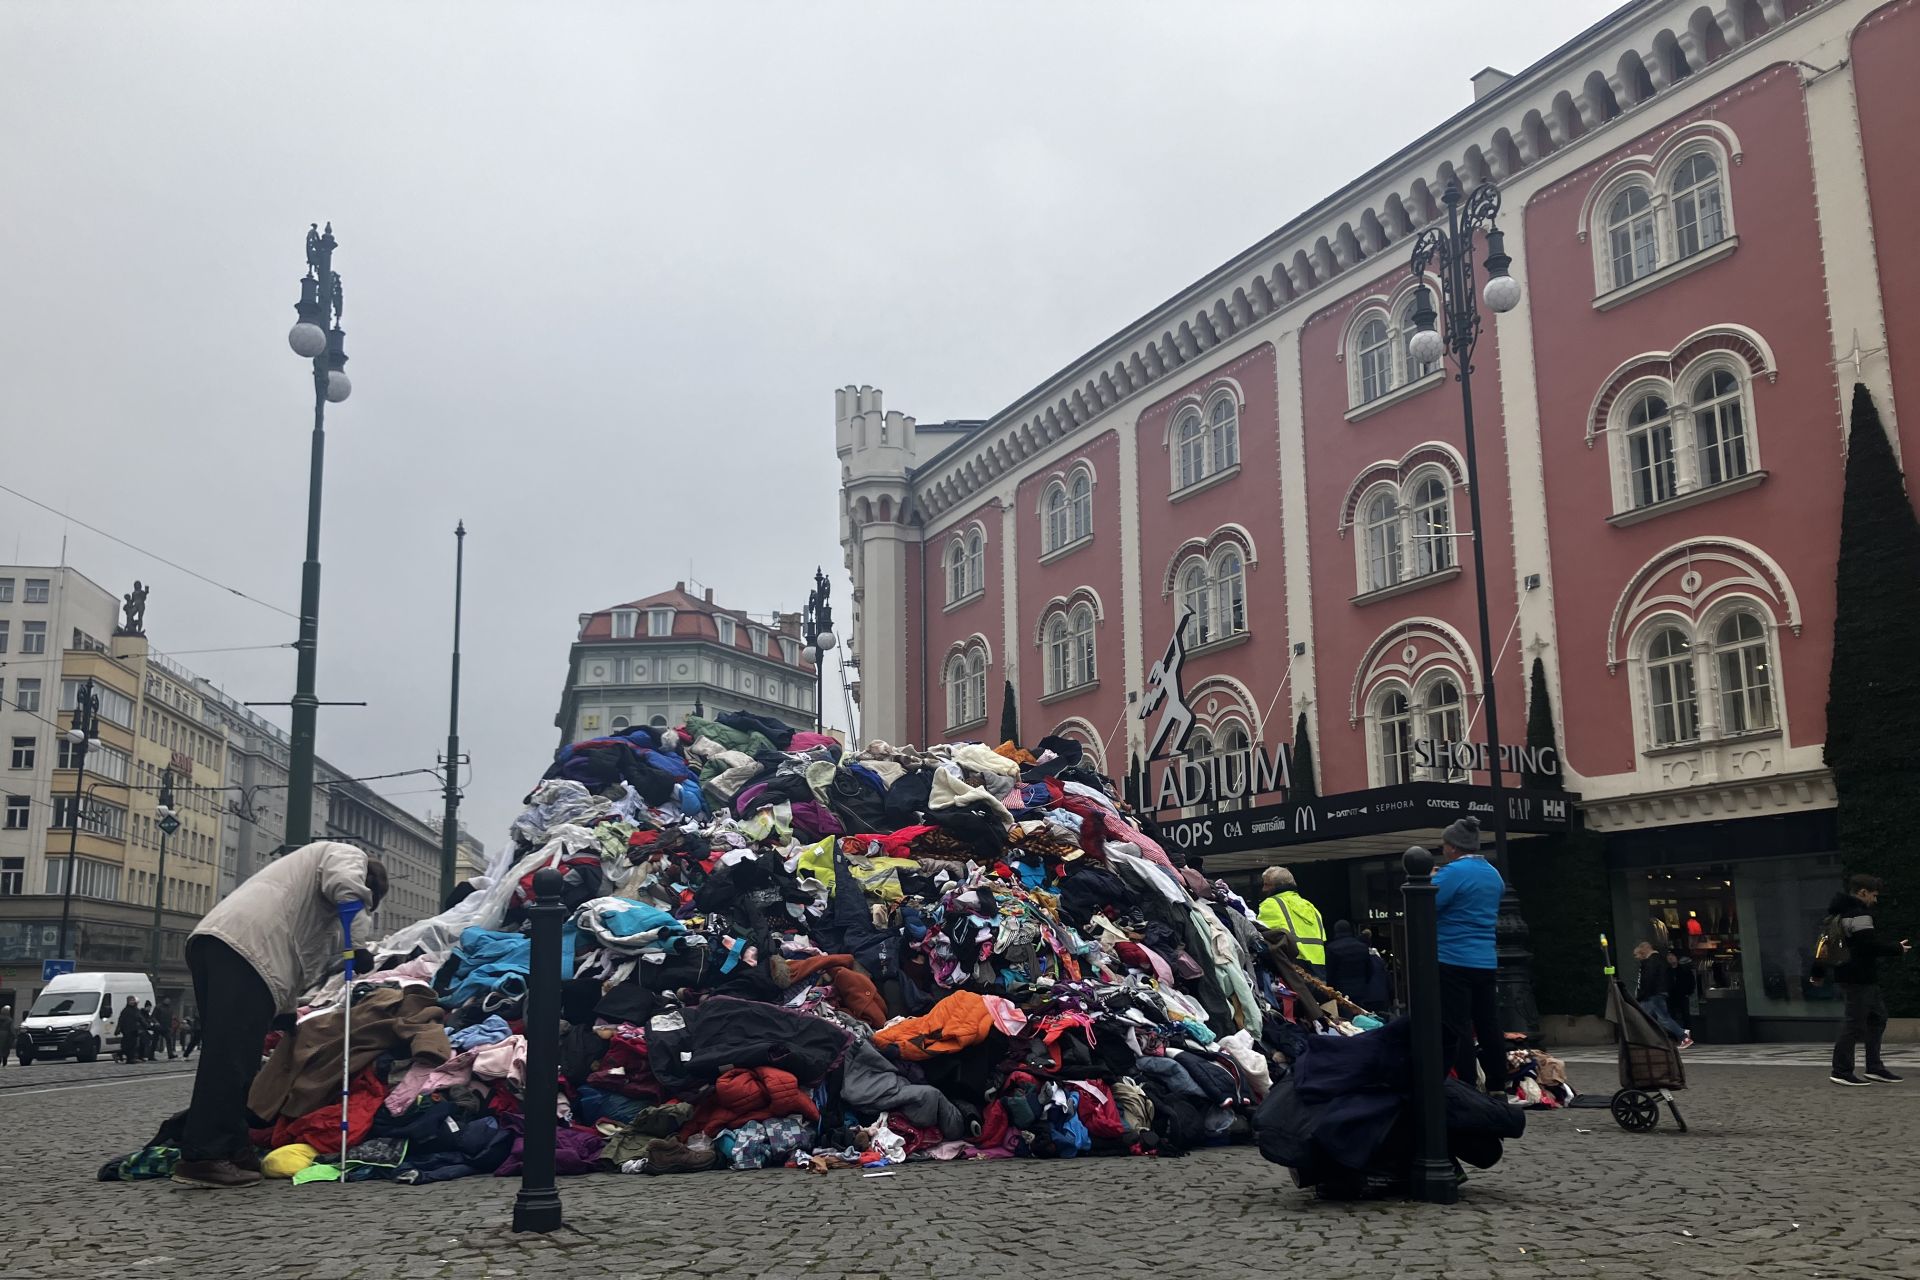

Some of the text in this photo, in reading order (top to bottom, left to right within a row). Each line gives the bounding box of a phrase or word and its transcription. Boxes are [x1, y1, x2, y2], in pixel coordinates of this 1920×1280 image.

[1121, 742, 1291, 814] LLADIUM
[1375, 800, 1415, 813] SEPHORA
[1426, 799, 1460, 809] CATCHES
[1467, 801, 1494, 813] Bata
[1508, 797, 1531, 820] GAP
[1162, 820, 1213, 848] HOPS
[1223, 820, 1243, 838] C&A
